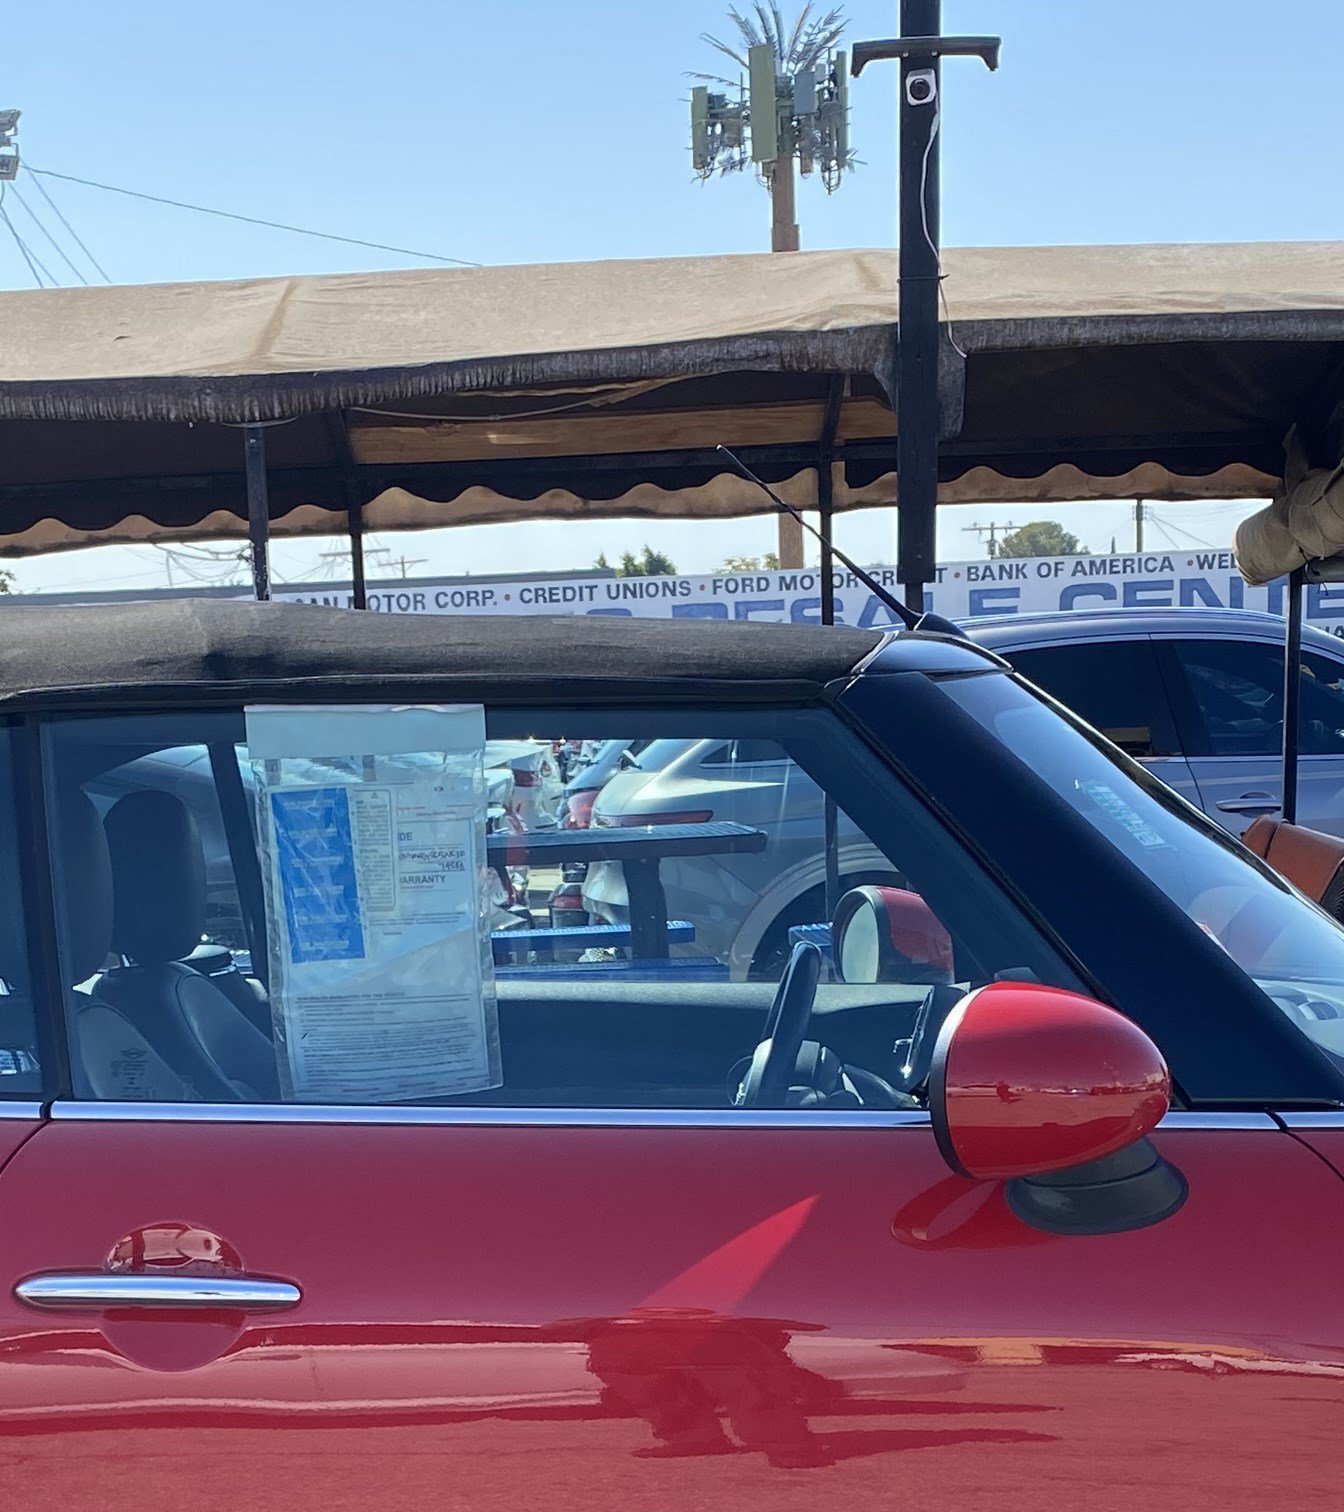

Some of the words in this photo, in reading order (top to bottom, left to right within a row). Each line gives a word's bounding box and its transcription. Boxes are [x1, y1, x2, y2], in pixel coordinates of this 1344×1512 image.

[348, 592, 426, 613] OTOR
[434, 589, 498, 609] CORP.
[519, 584, 599, 604] CREDIT
[606, 579, 692, 601] UNIONS
[712, 575, 770, 595] FORD
[778, 568, 860, 592] MOOR
[870, 567, 948, 587] CRT
[966, 562, 1029, 582] BANK
[1036, 560, 1065, 579] OF
[1071, 555, 1175, 576] AMERICA
[399, 874, 446, 885] ARRANTY
